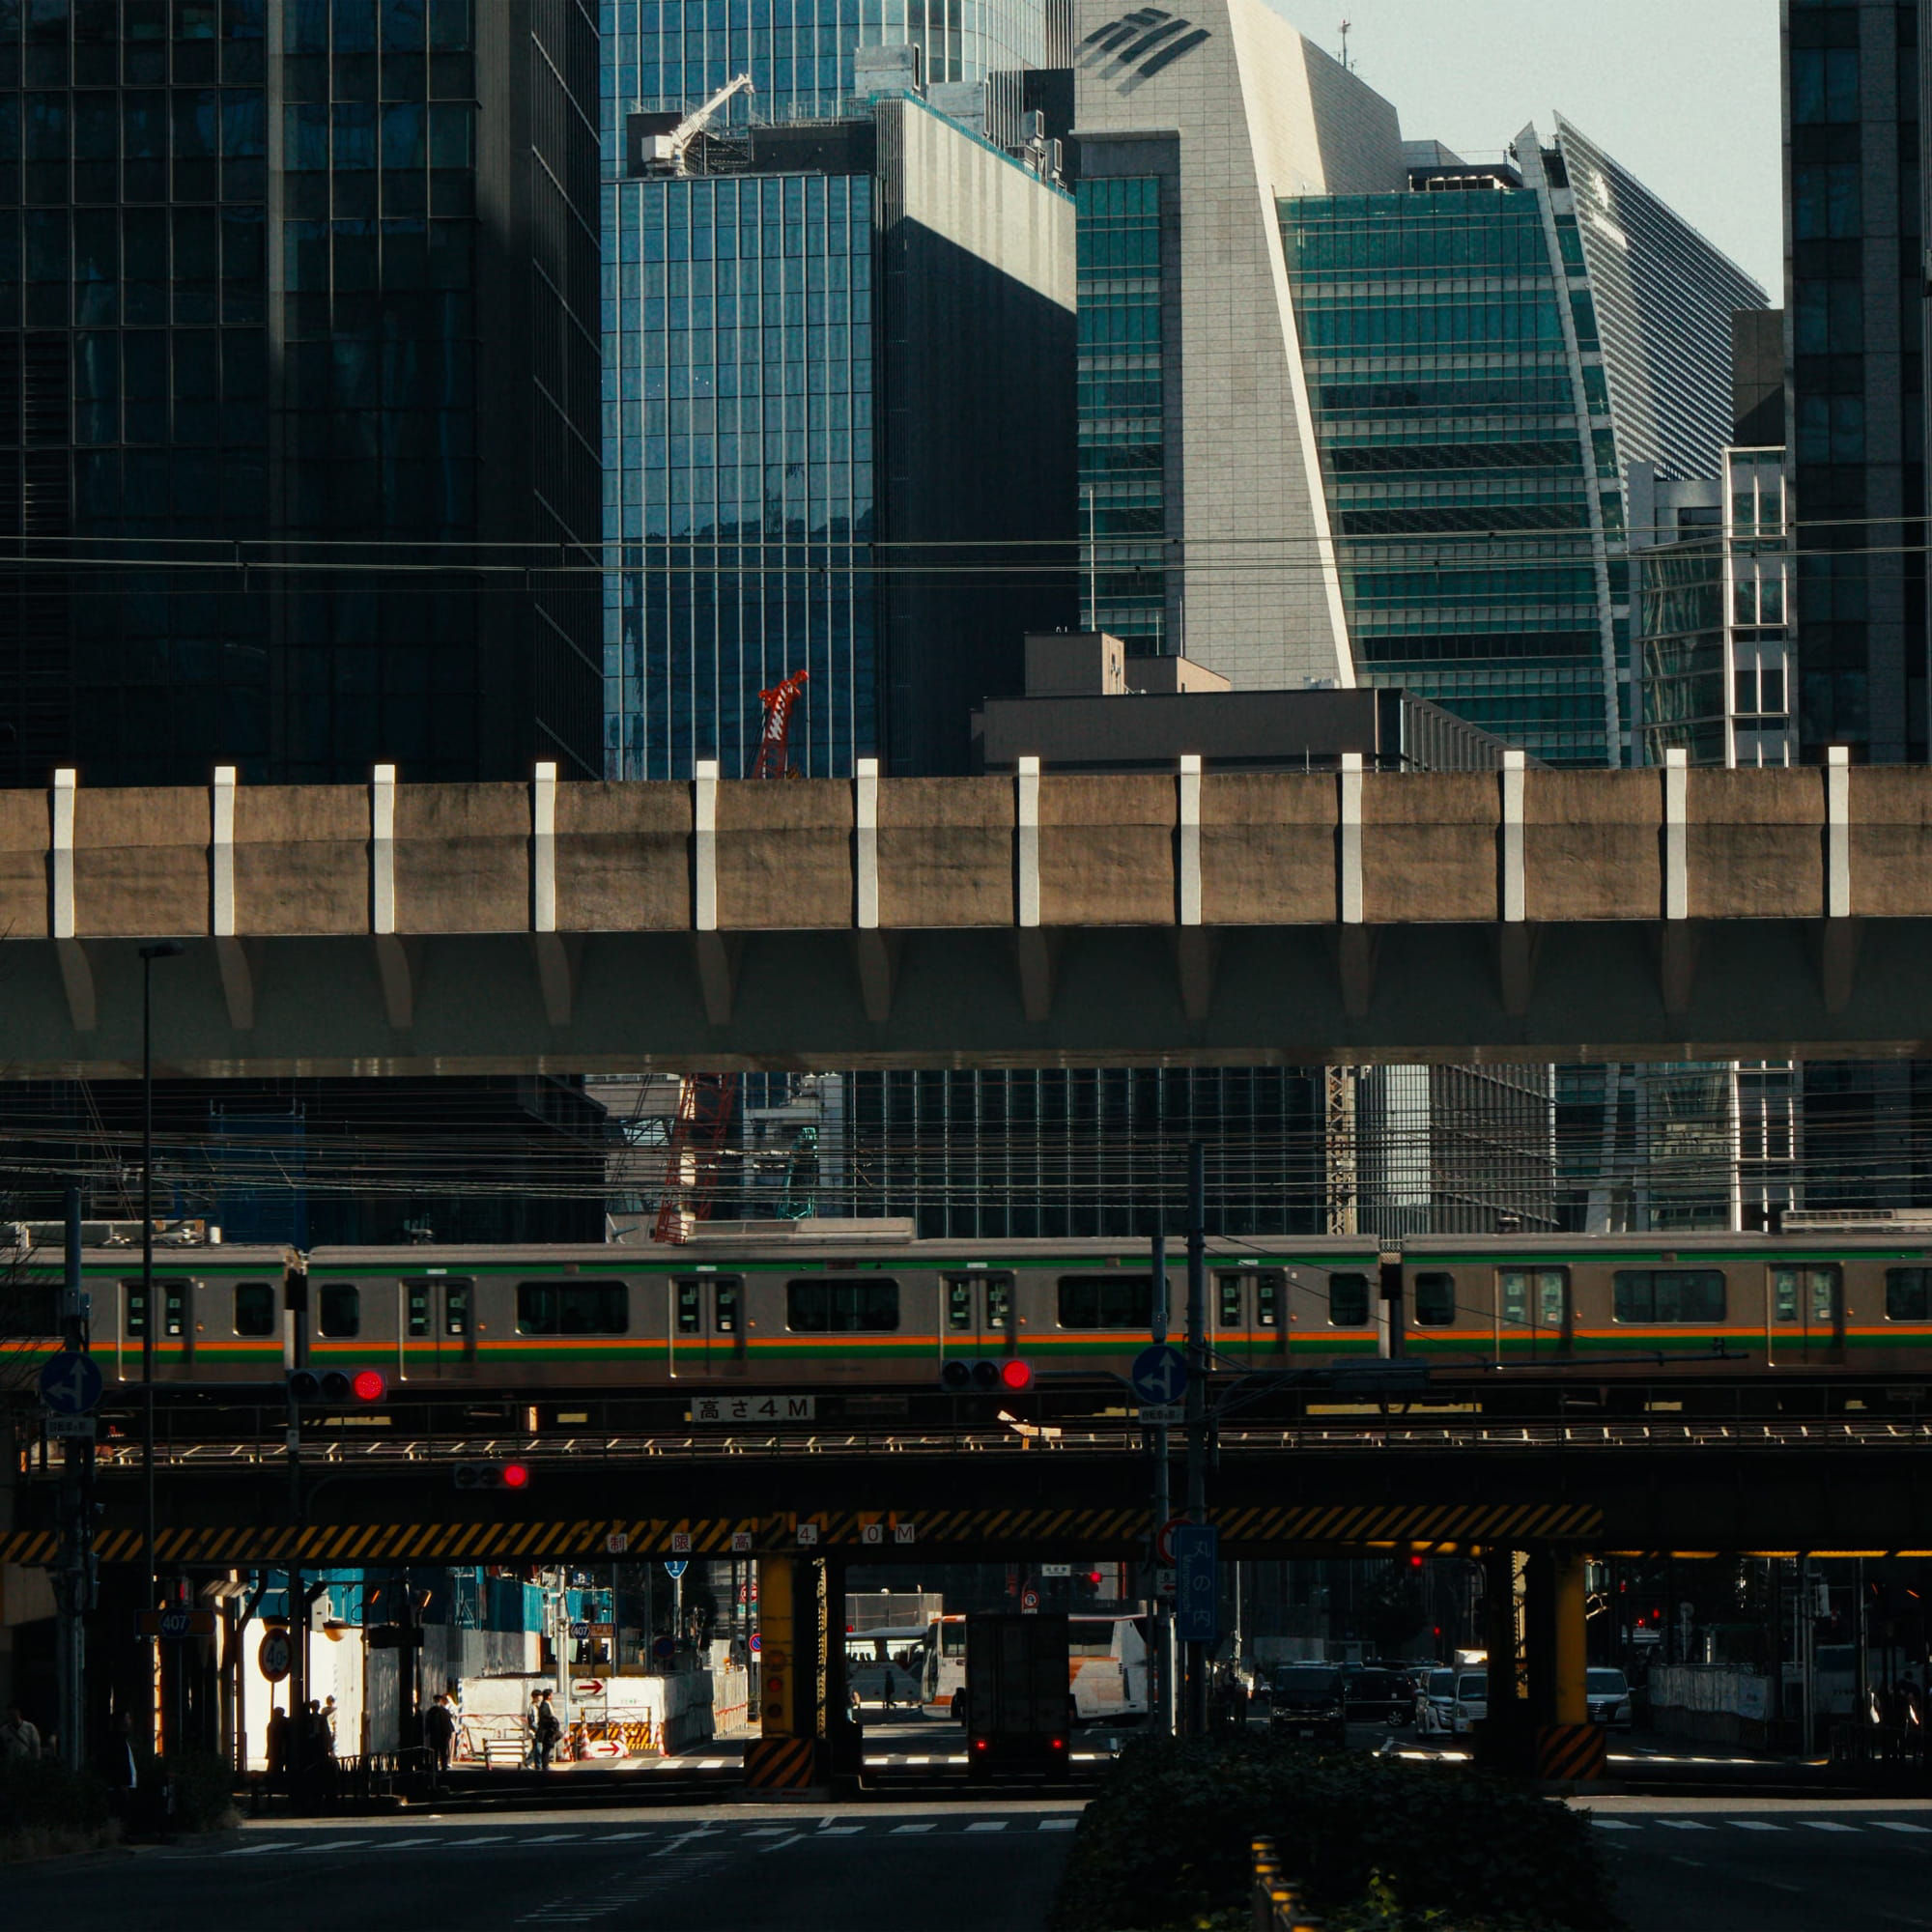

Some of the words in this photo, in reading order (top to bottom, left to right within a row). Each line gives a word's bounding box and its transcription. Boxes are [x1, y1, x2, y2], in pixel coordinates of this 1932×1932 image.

[1191, 1540, 1211, 1628] 丸の内
[161, 1614, 187, 1631] 407
[573, 1626, 588, 1636] 407
